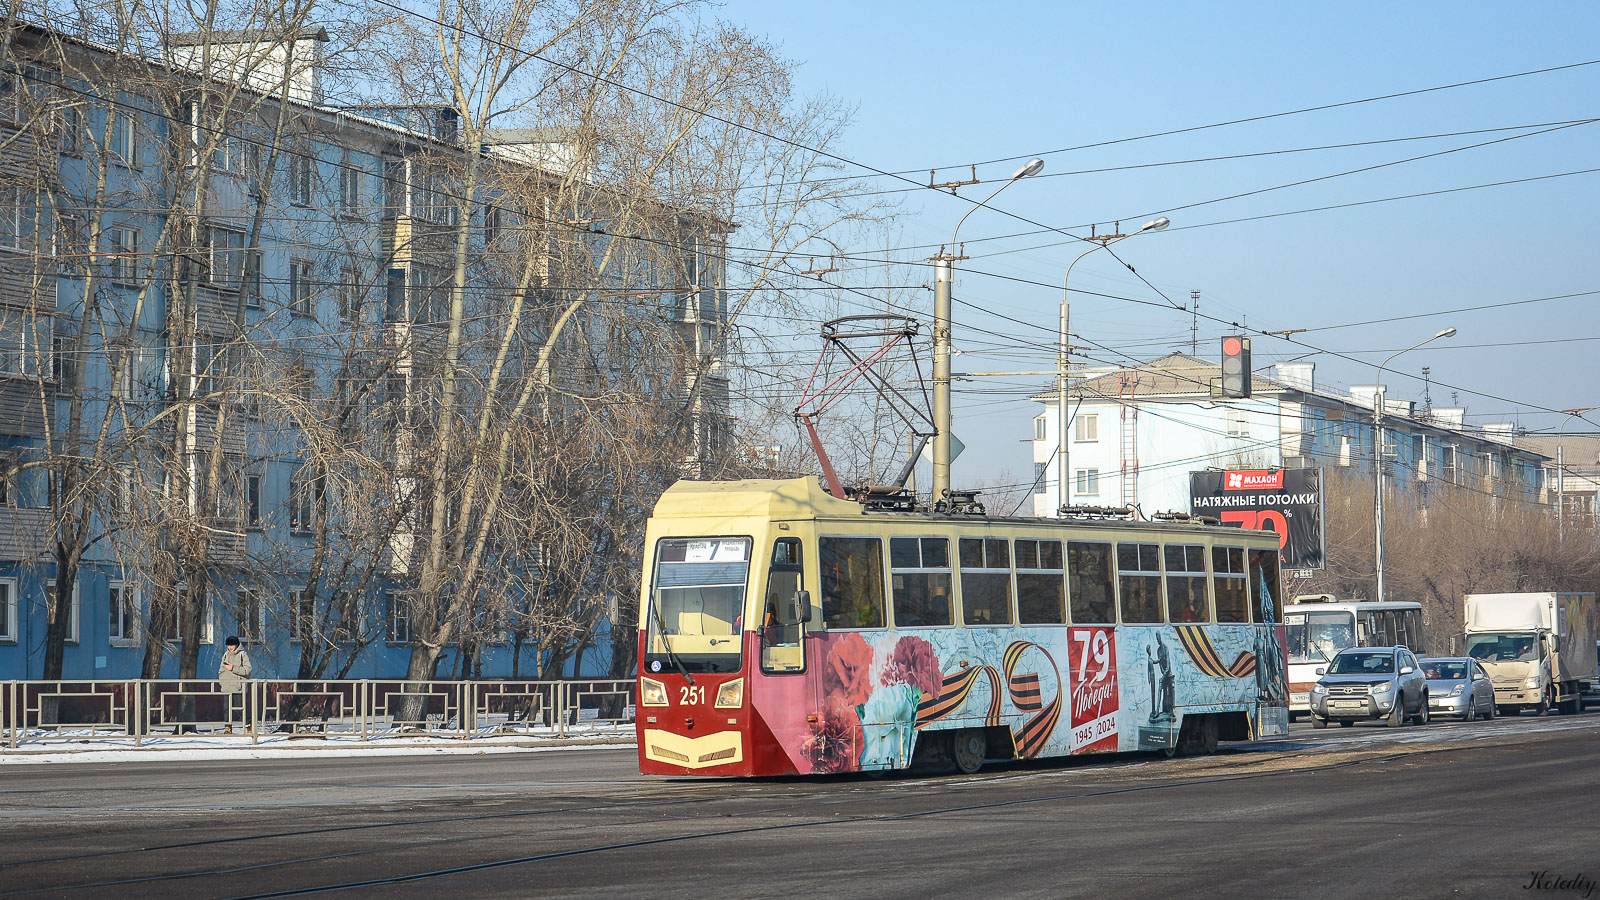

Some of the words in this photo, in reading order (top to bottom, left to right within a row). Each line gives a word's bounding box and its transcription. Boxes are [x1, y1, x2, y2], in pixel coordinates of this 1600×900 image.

[1244, 475, 1277, 484] МАХАОН
[1193, 496, 1256, 508] НАТЯЖНЫЕ
[1258, 494, 1315, 505] ПОТОЛКИ
[709, 541, 720, 560] 7
[1073, 630, 1110, 682] 79
[680, 685, 705, 706] 251
[1075, 726, 1093, 745] 1945
[1097, 717, 1116, 736] 2024
